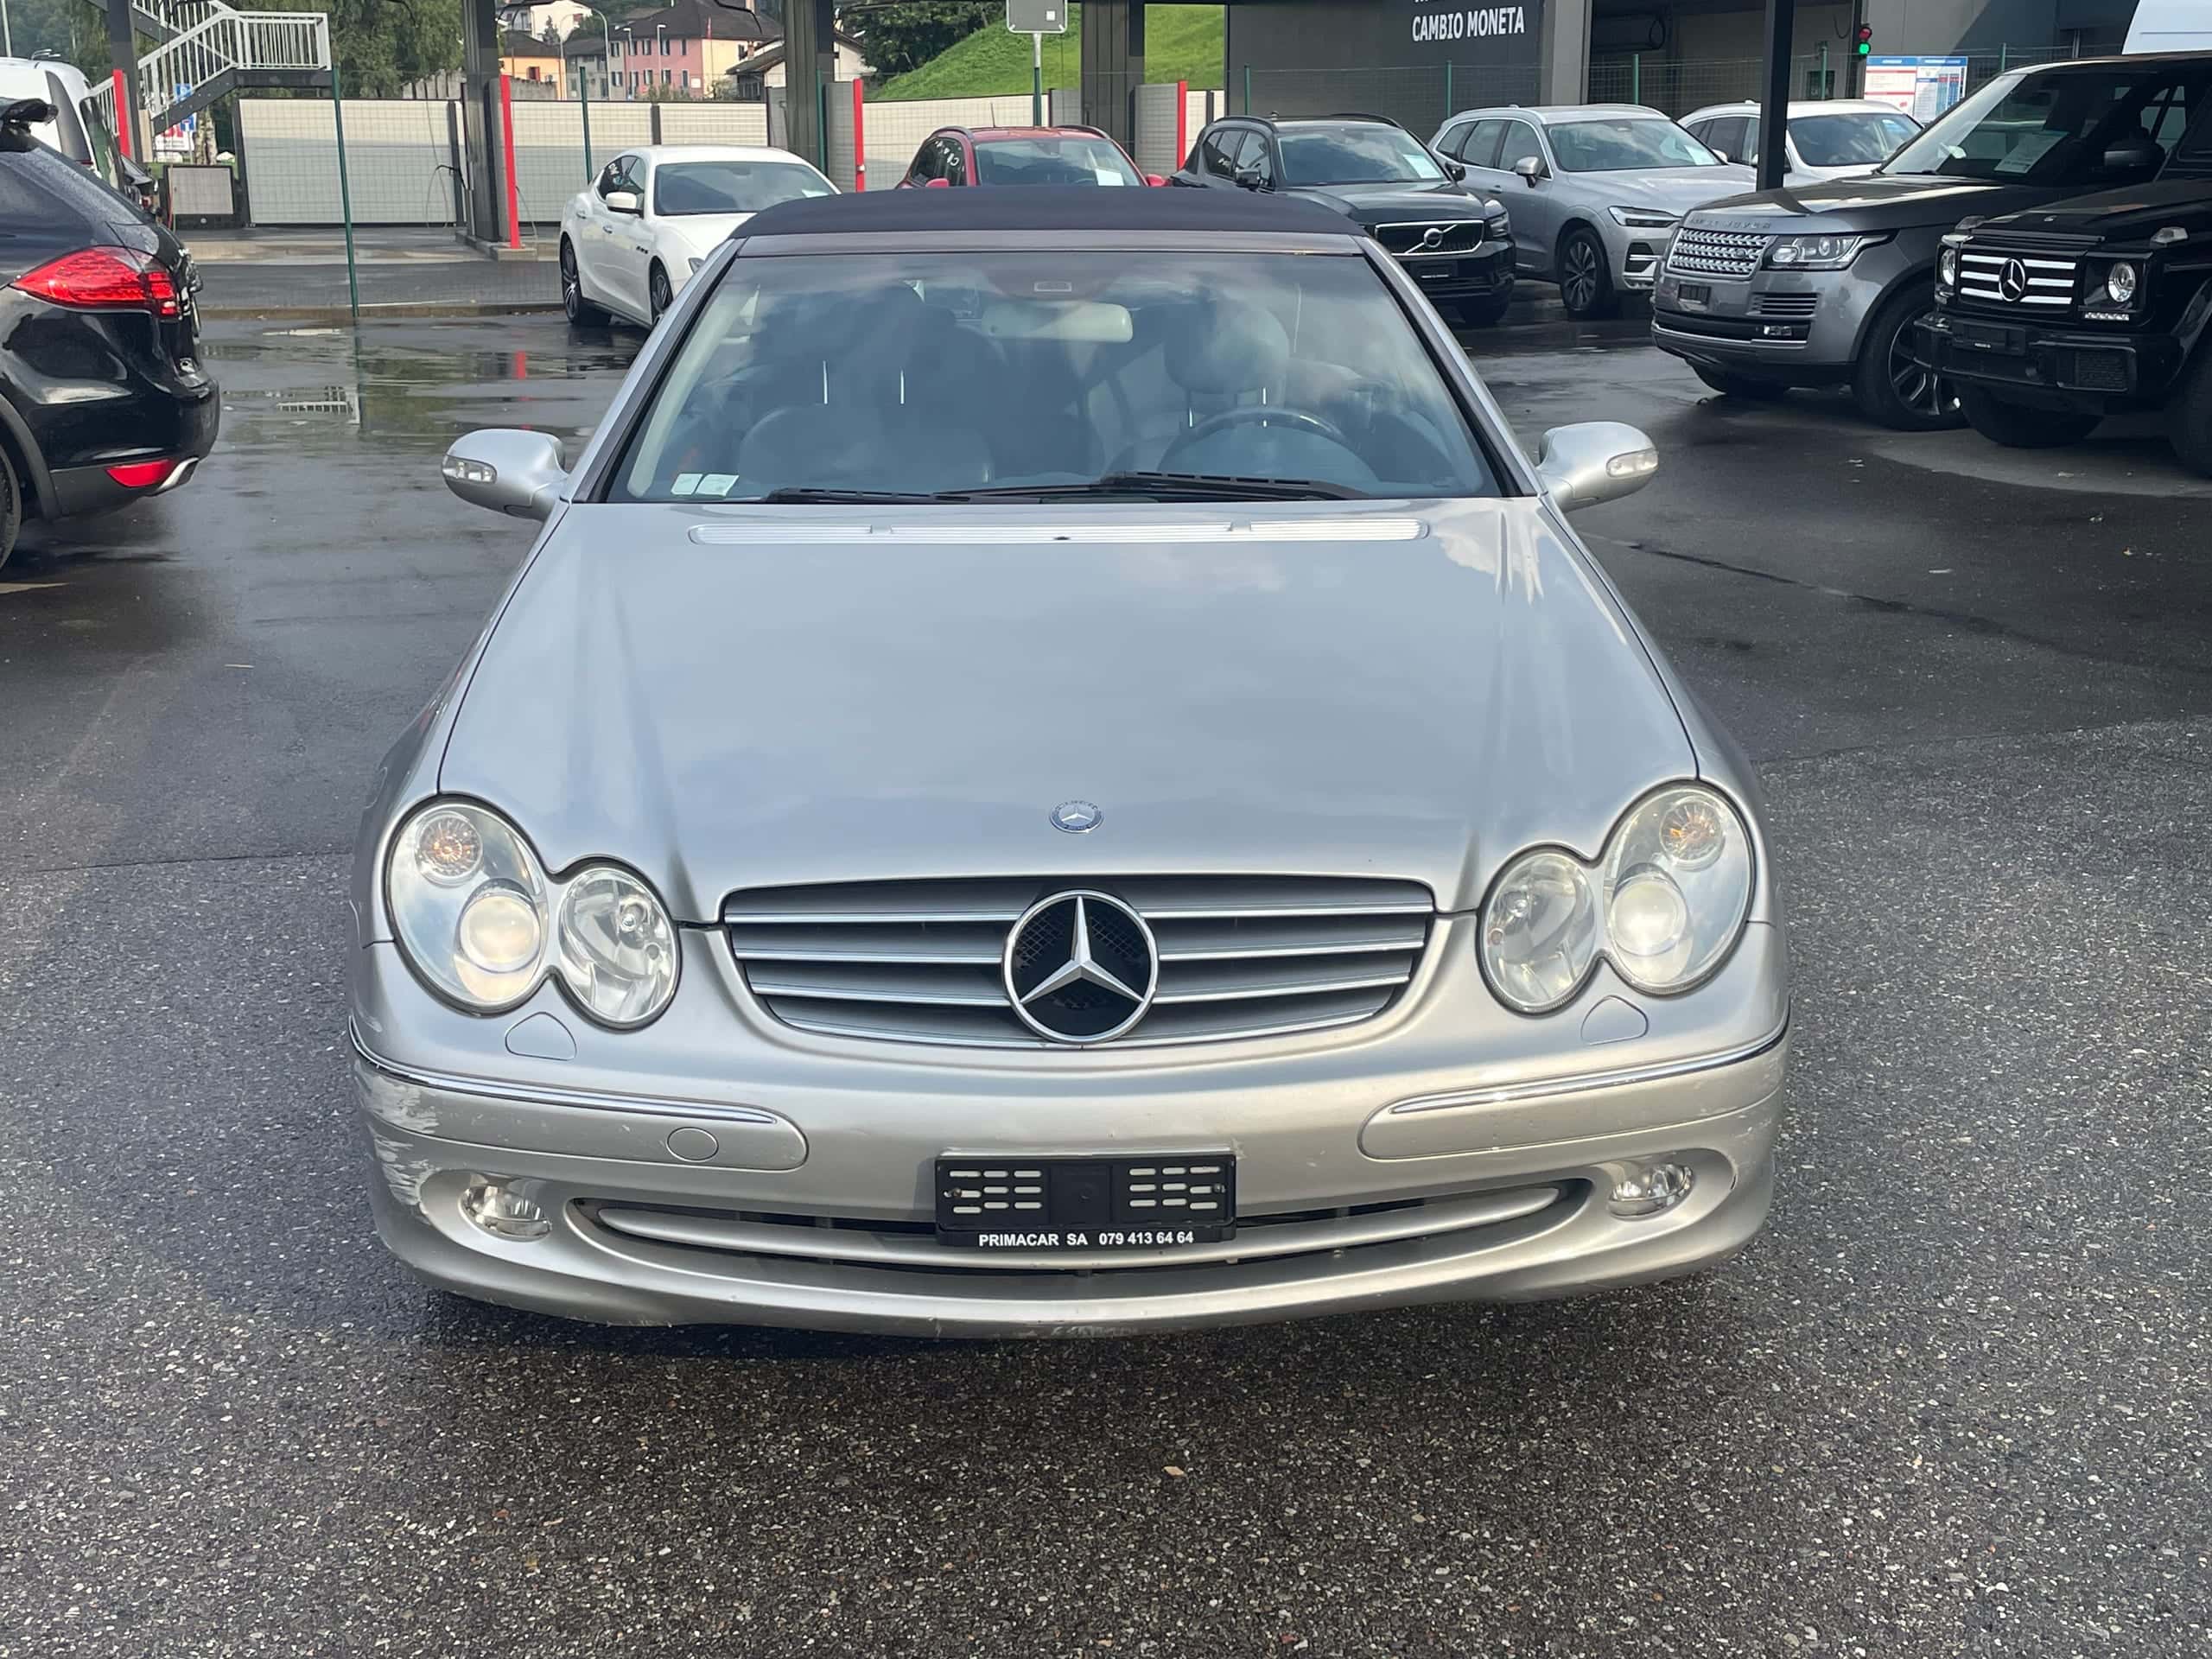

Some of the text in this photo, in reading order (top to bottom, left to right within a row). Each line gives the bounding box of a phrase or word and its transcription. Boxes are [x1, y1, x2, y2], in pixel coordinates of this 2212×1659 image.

[1412, 6, 1525, 41] CAMBIO MONETA
[978, 1230, 1194, 1247] PRIMACAR SA 079 413 64 64
